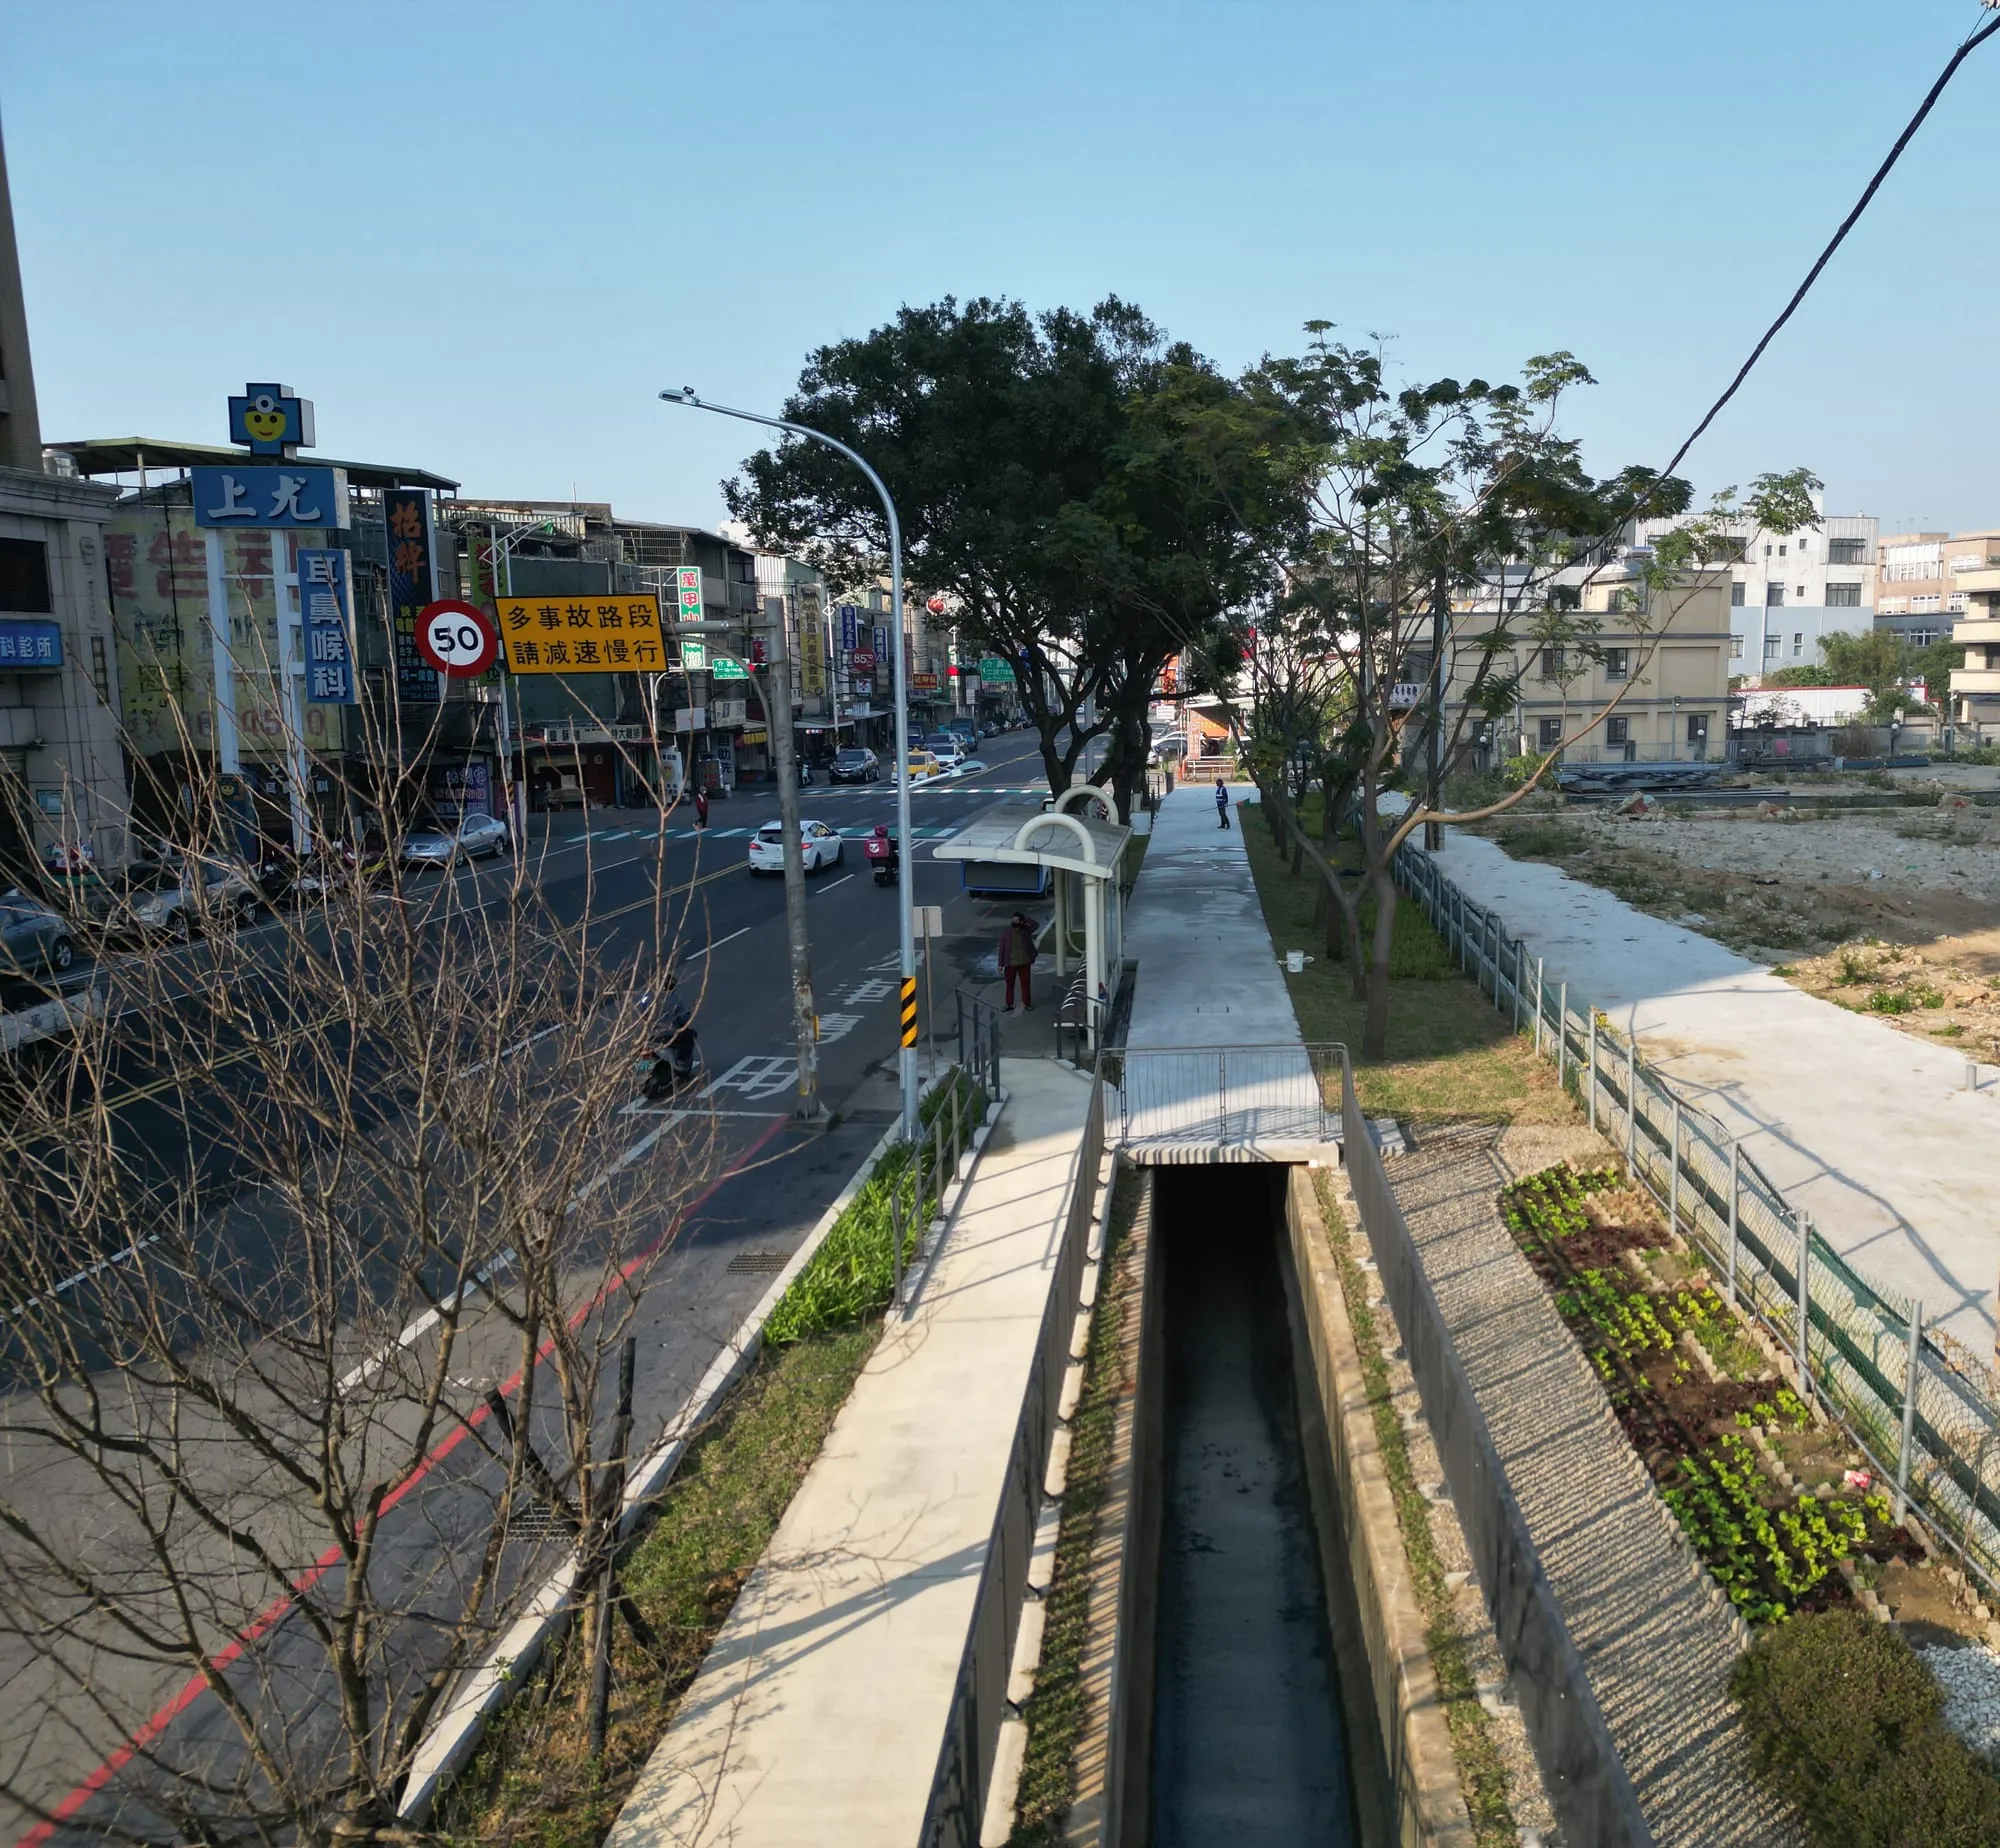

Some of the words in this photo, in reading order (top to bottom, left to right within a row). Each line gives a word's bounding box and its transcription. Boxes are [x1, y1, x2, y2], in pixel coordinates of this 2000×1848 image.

[207, 474, 321, 521] 上尤
[390, 500, 426, 585] 招牌
[305, 555, 347, 697] 耳鼻喉科
[508, 603, 655, 631] 多事故路段
[0, 636, 52, 658] 科診所
[434, 625, 479, 653] 50
[512, 638, 659, 666] 請減速慢行
